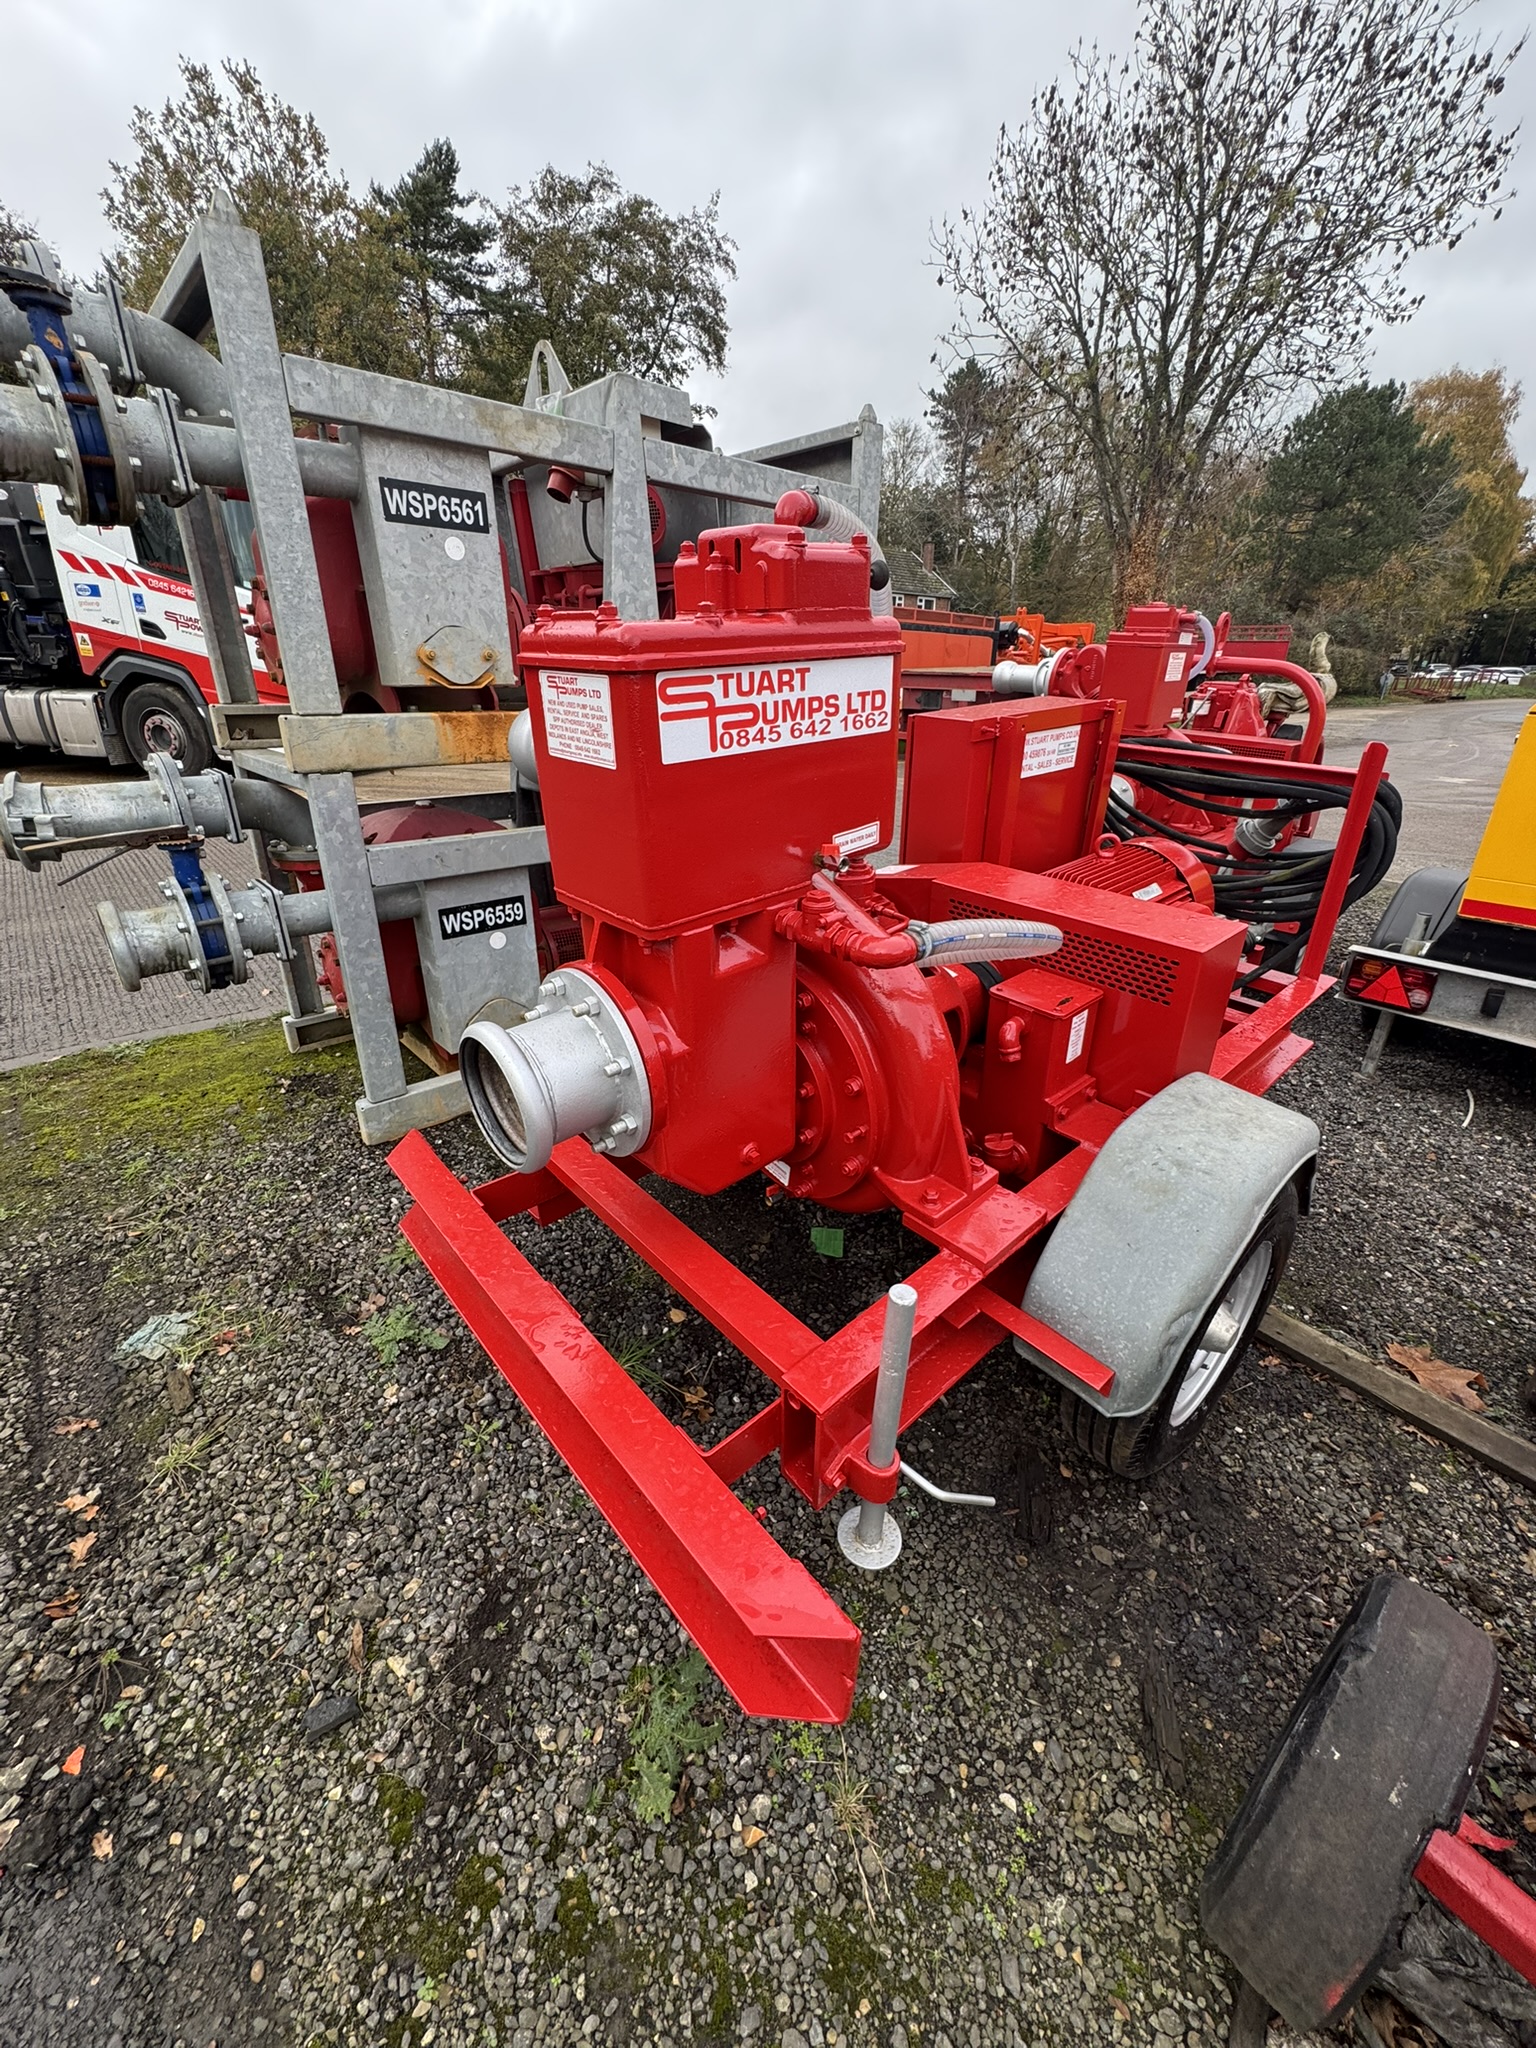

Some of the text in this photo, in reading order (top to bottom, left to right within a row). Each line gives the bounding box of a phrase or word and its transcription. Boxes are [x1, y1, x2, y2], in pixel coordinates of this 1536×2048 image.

[384, 486, 484, 527] WSP6561
[148, 578, 169, 591] 0845
[164, 610, 201, 624] STUAR
[546, 675, 578, 688] STUART
[557, 686, 602, 700] PUMPS LTD
[658, 667, 811, 721] STUART
[591, 714, 608, 722] SPARES
[708, 690, 886, 752] PUMPS LTD
[719, 710, 888, 750] 0845 642 1662
[442, 902, 524, 934] WSP6559
